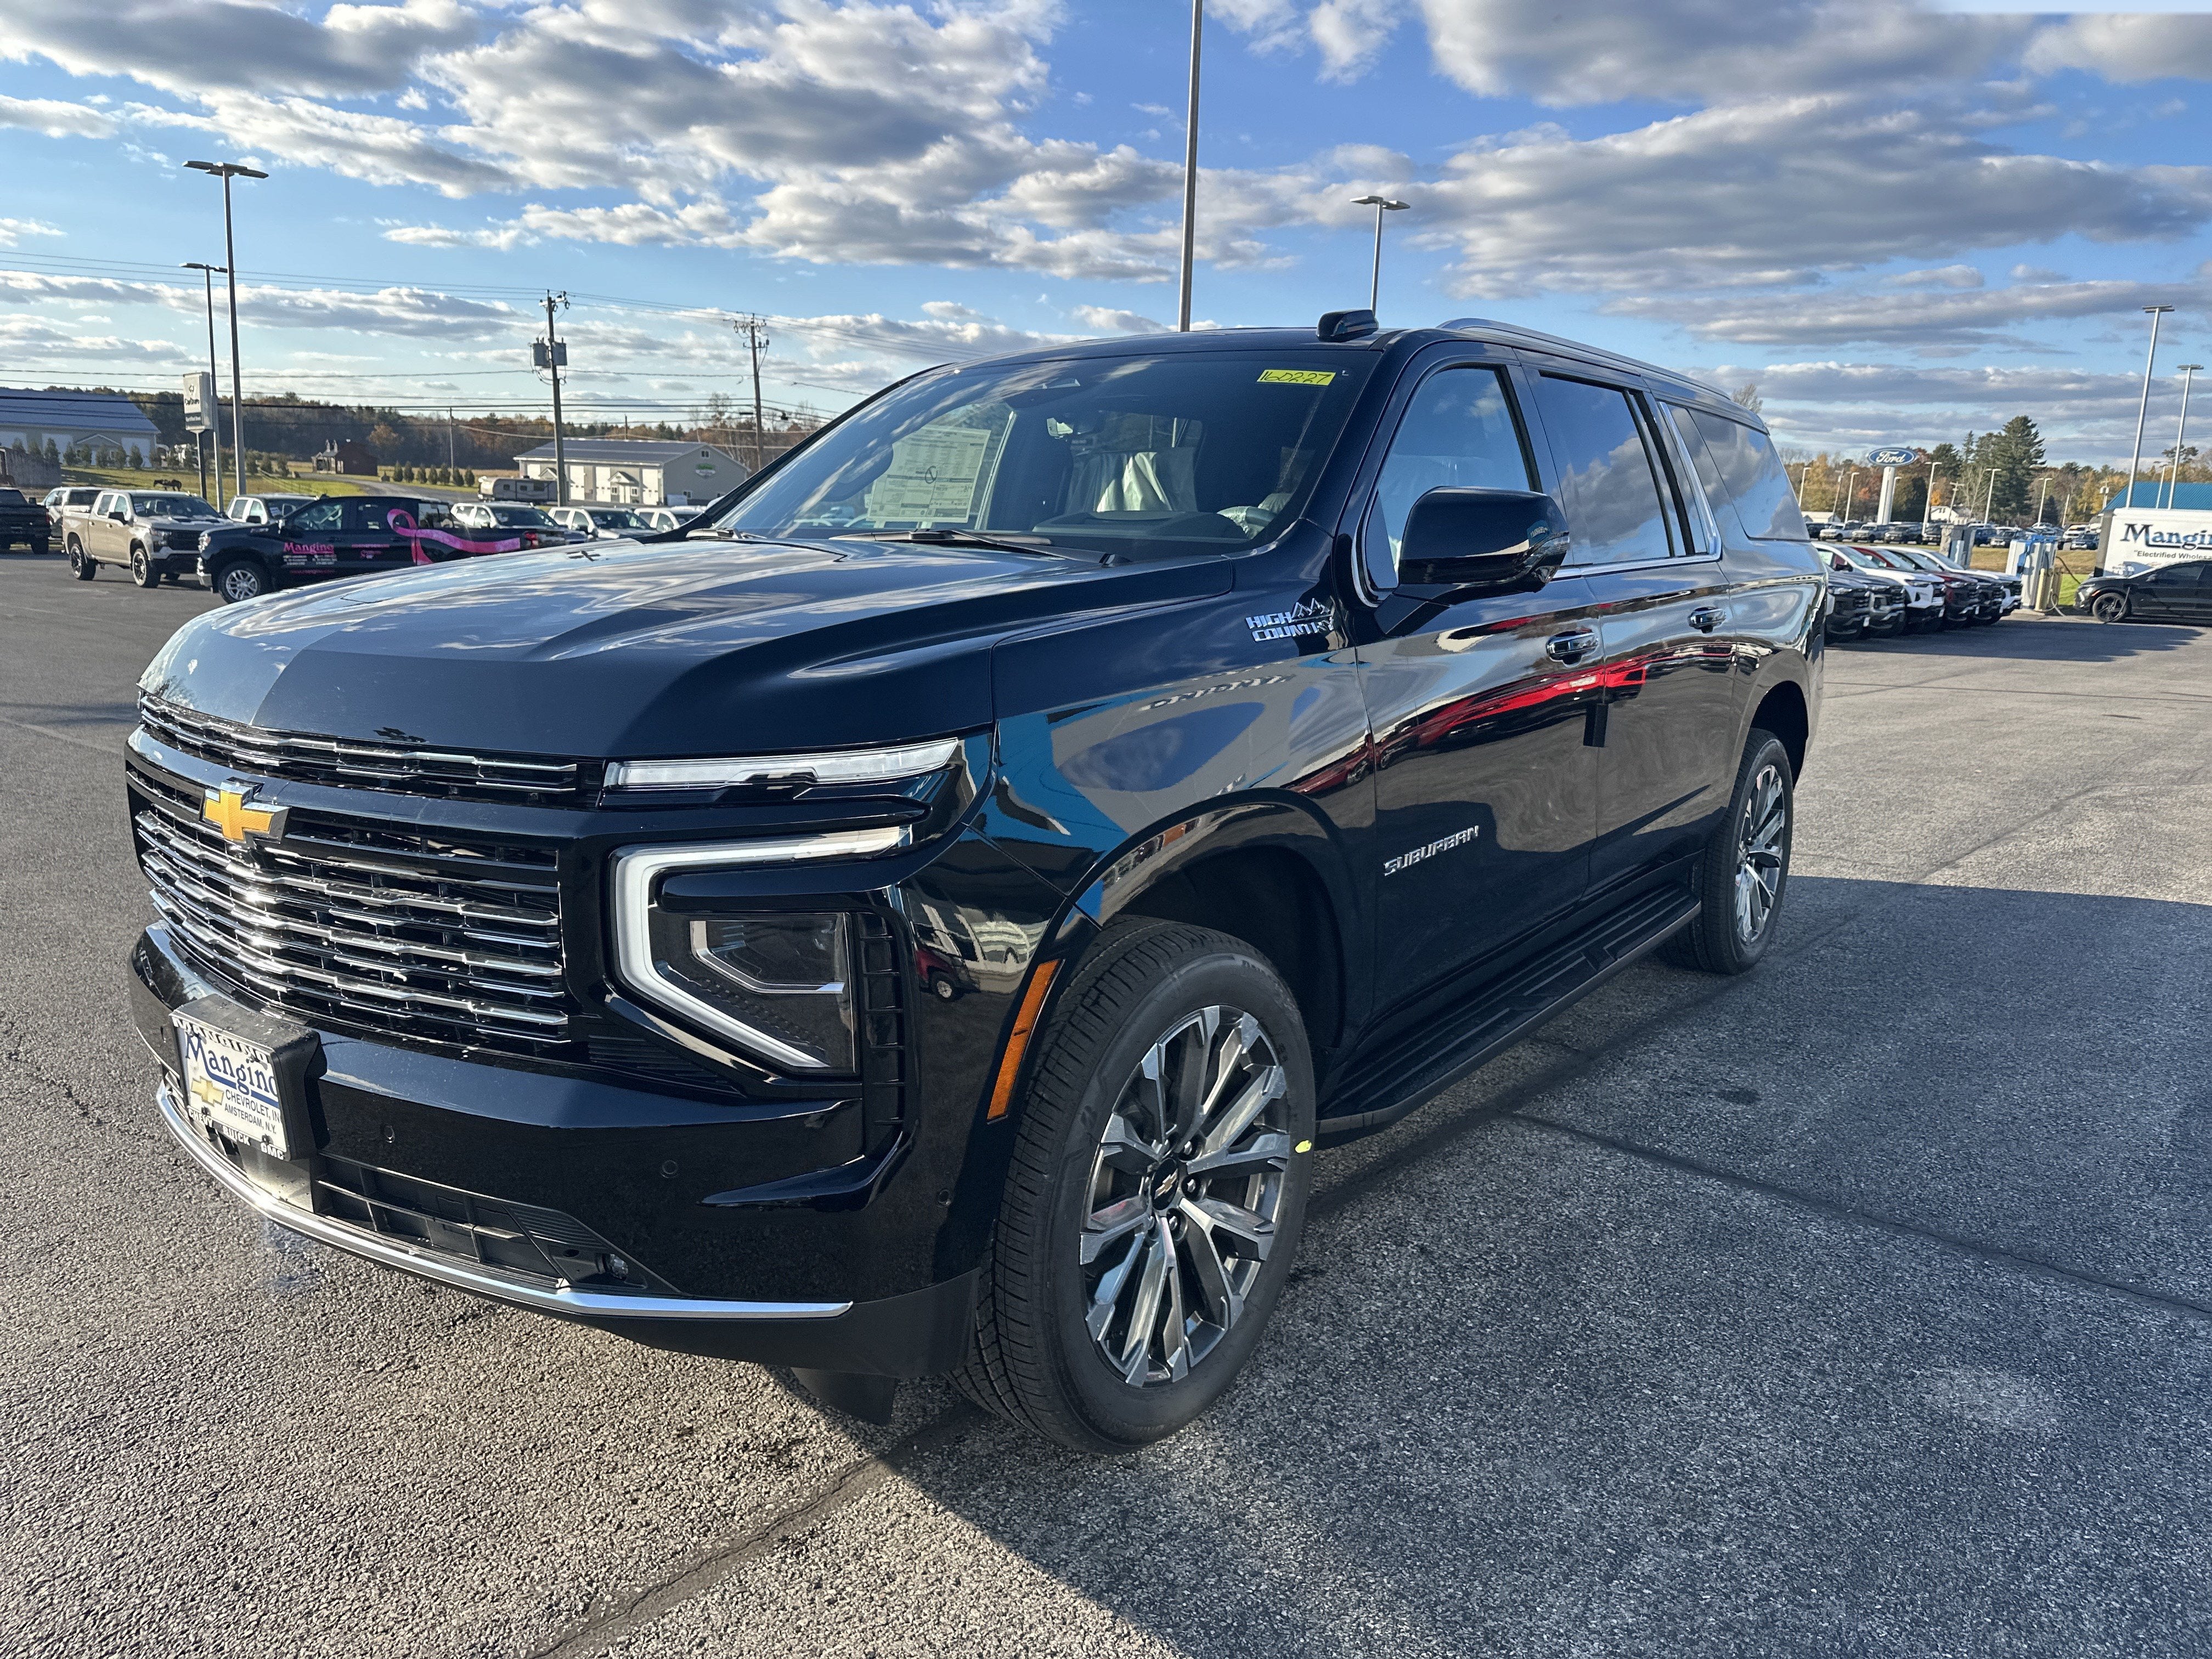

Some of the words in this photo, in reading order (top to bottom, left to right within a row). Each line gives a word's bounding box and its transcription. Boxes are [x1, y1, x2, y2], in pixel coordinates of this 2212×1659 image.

[1876, 450, 1906, 463] Ford
[283, 541, 334, 555] Mangino
[1245, 611, 1293, 629] HIGH
[1252, 616, 1334, 642] COUNTRY
[1384, 825, 1479, 876] SUBURBAN
[172, 1016, 269, 1065] MANGINO
[226, 1089, 270, 1120] CHEVROLET,
[188, 1108, 213, 1127] CHEVY
[225, 1103, 264, 1130] AMSTERDAM,
[222, 1126, 250, 1146] BUICK
[261, 1142, 284, 1160] GMC
